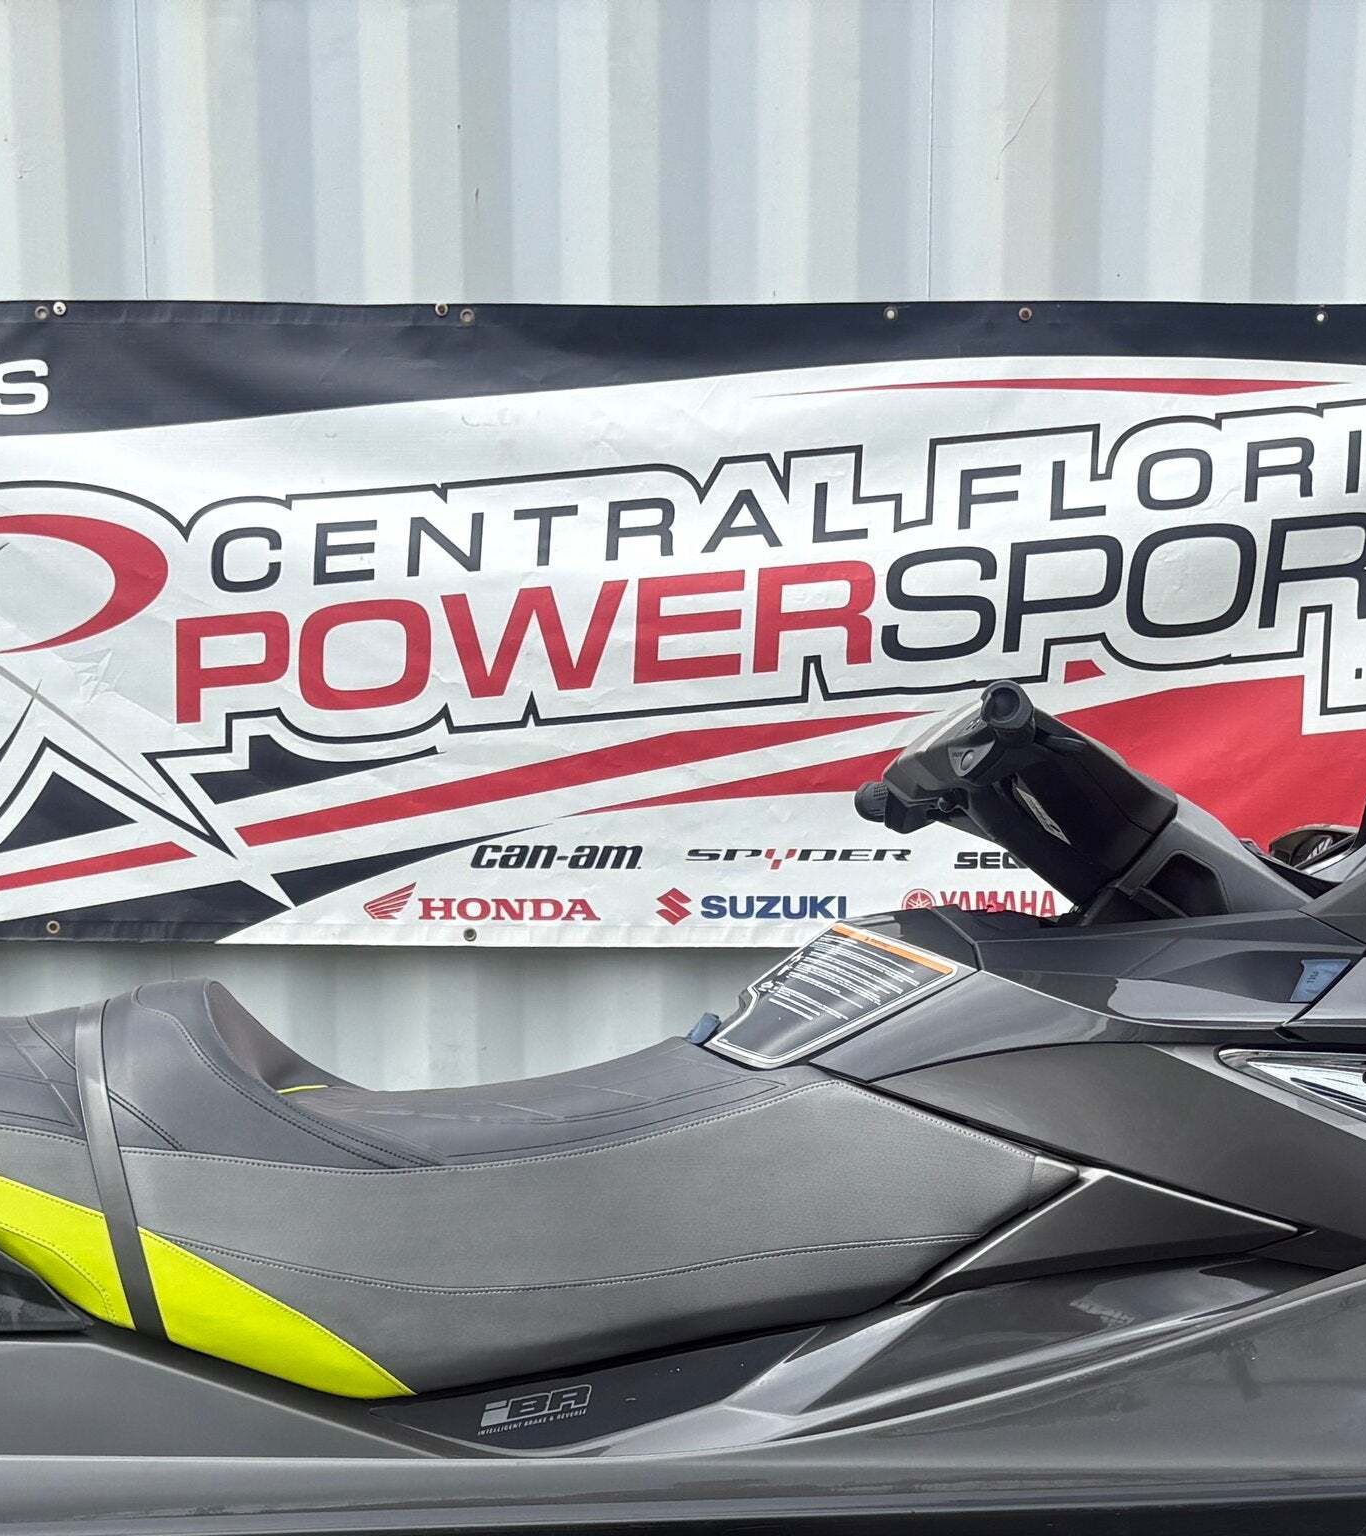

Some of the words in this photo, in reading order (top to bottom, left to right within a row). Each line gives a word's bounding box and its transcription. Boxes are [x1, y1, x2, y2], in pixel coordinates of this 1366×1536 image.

[211, 482, 869, 593] CENTRAL
[685, 848, 912, 869] SPYDER
[418, 898, 601, 921] HONDA
[700, 895, 847, 920] SUZUKI
[940, 890, 1056, 917] YAMAHA
